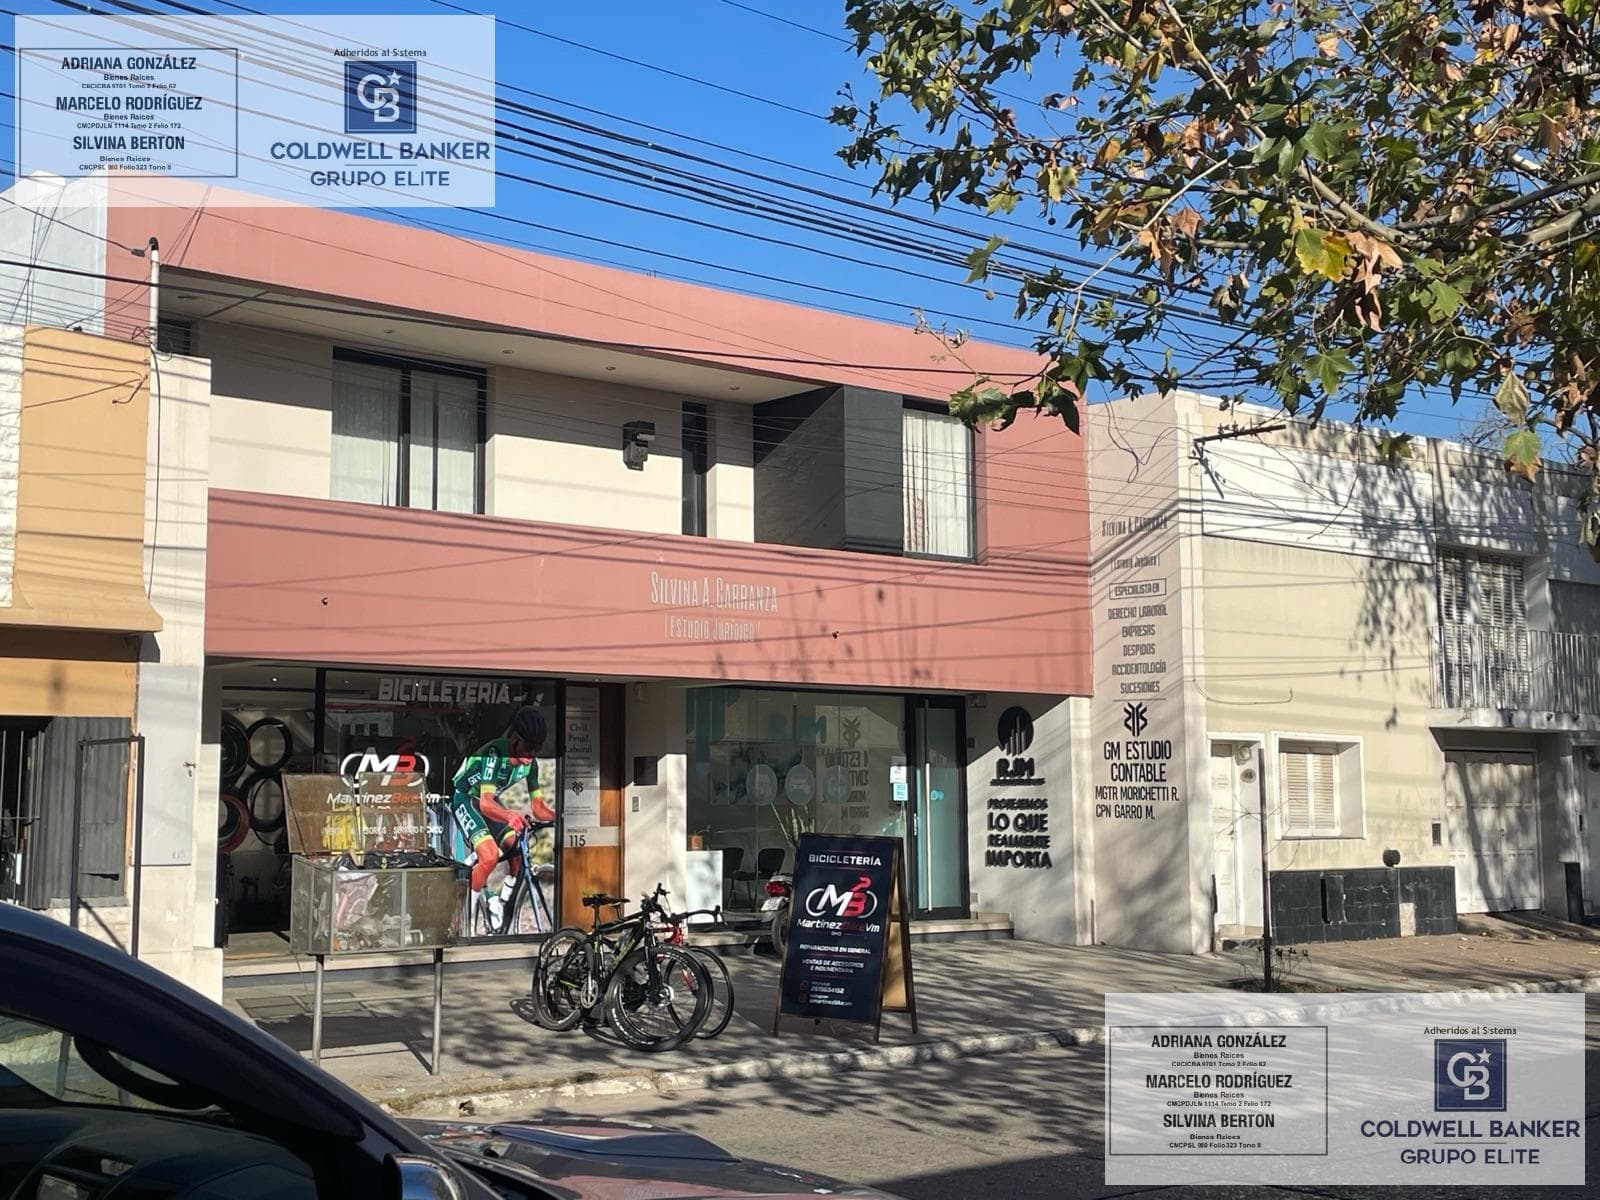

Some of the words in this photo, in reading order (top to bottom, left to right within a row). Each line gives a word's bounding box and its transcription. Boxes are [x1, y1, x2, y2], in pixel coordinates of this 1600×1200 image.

[650, 571, 698, 607] SILVINA
[716, 576, 778, 612] CARRANZA
[1108, 606, 1137, 620] DERECHO
[1139, 604, 1168, 618] LABORAL
[1121, 624, 1156, 638] EMPRESAS
[1123, 643, 1156, 657] DESPIDOS
[1111, 660, 1167, 676] ACCIDENTOLOGÍA
[1120, 681, 1160, 694] SUCESIONES
[1103, 741, 1121, 760] GM
[1126, 740, 1172, 760] ESTUDIO
[1110, 763, 1167, 782] CONTABLE
[1095, 786, 1118, 800] MGTR
[1120, 786, 1169, 801] MORICHETTI
[1171, 786, 1180, 801] R.
[1095, 803, 1112, 818] CPN
[1114, 804, 1143, 819] GARRO
[1145, 805, 1155, 820] M.
[987, 812, 1010, 832] LO
[1013, 812, 1049, 833] QUE
[569, 834, 586, 848] 115
[987, 833, 1051, 850] REALMENTE
[985, 850, 1053, 870] IMPORTA
